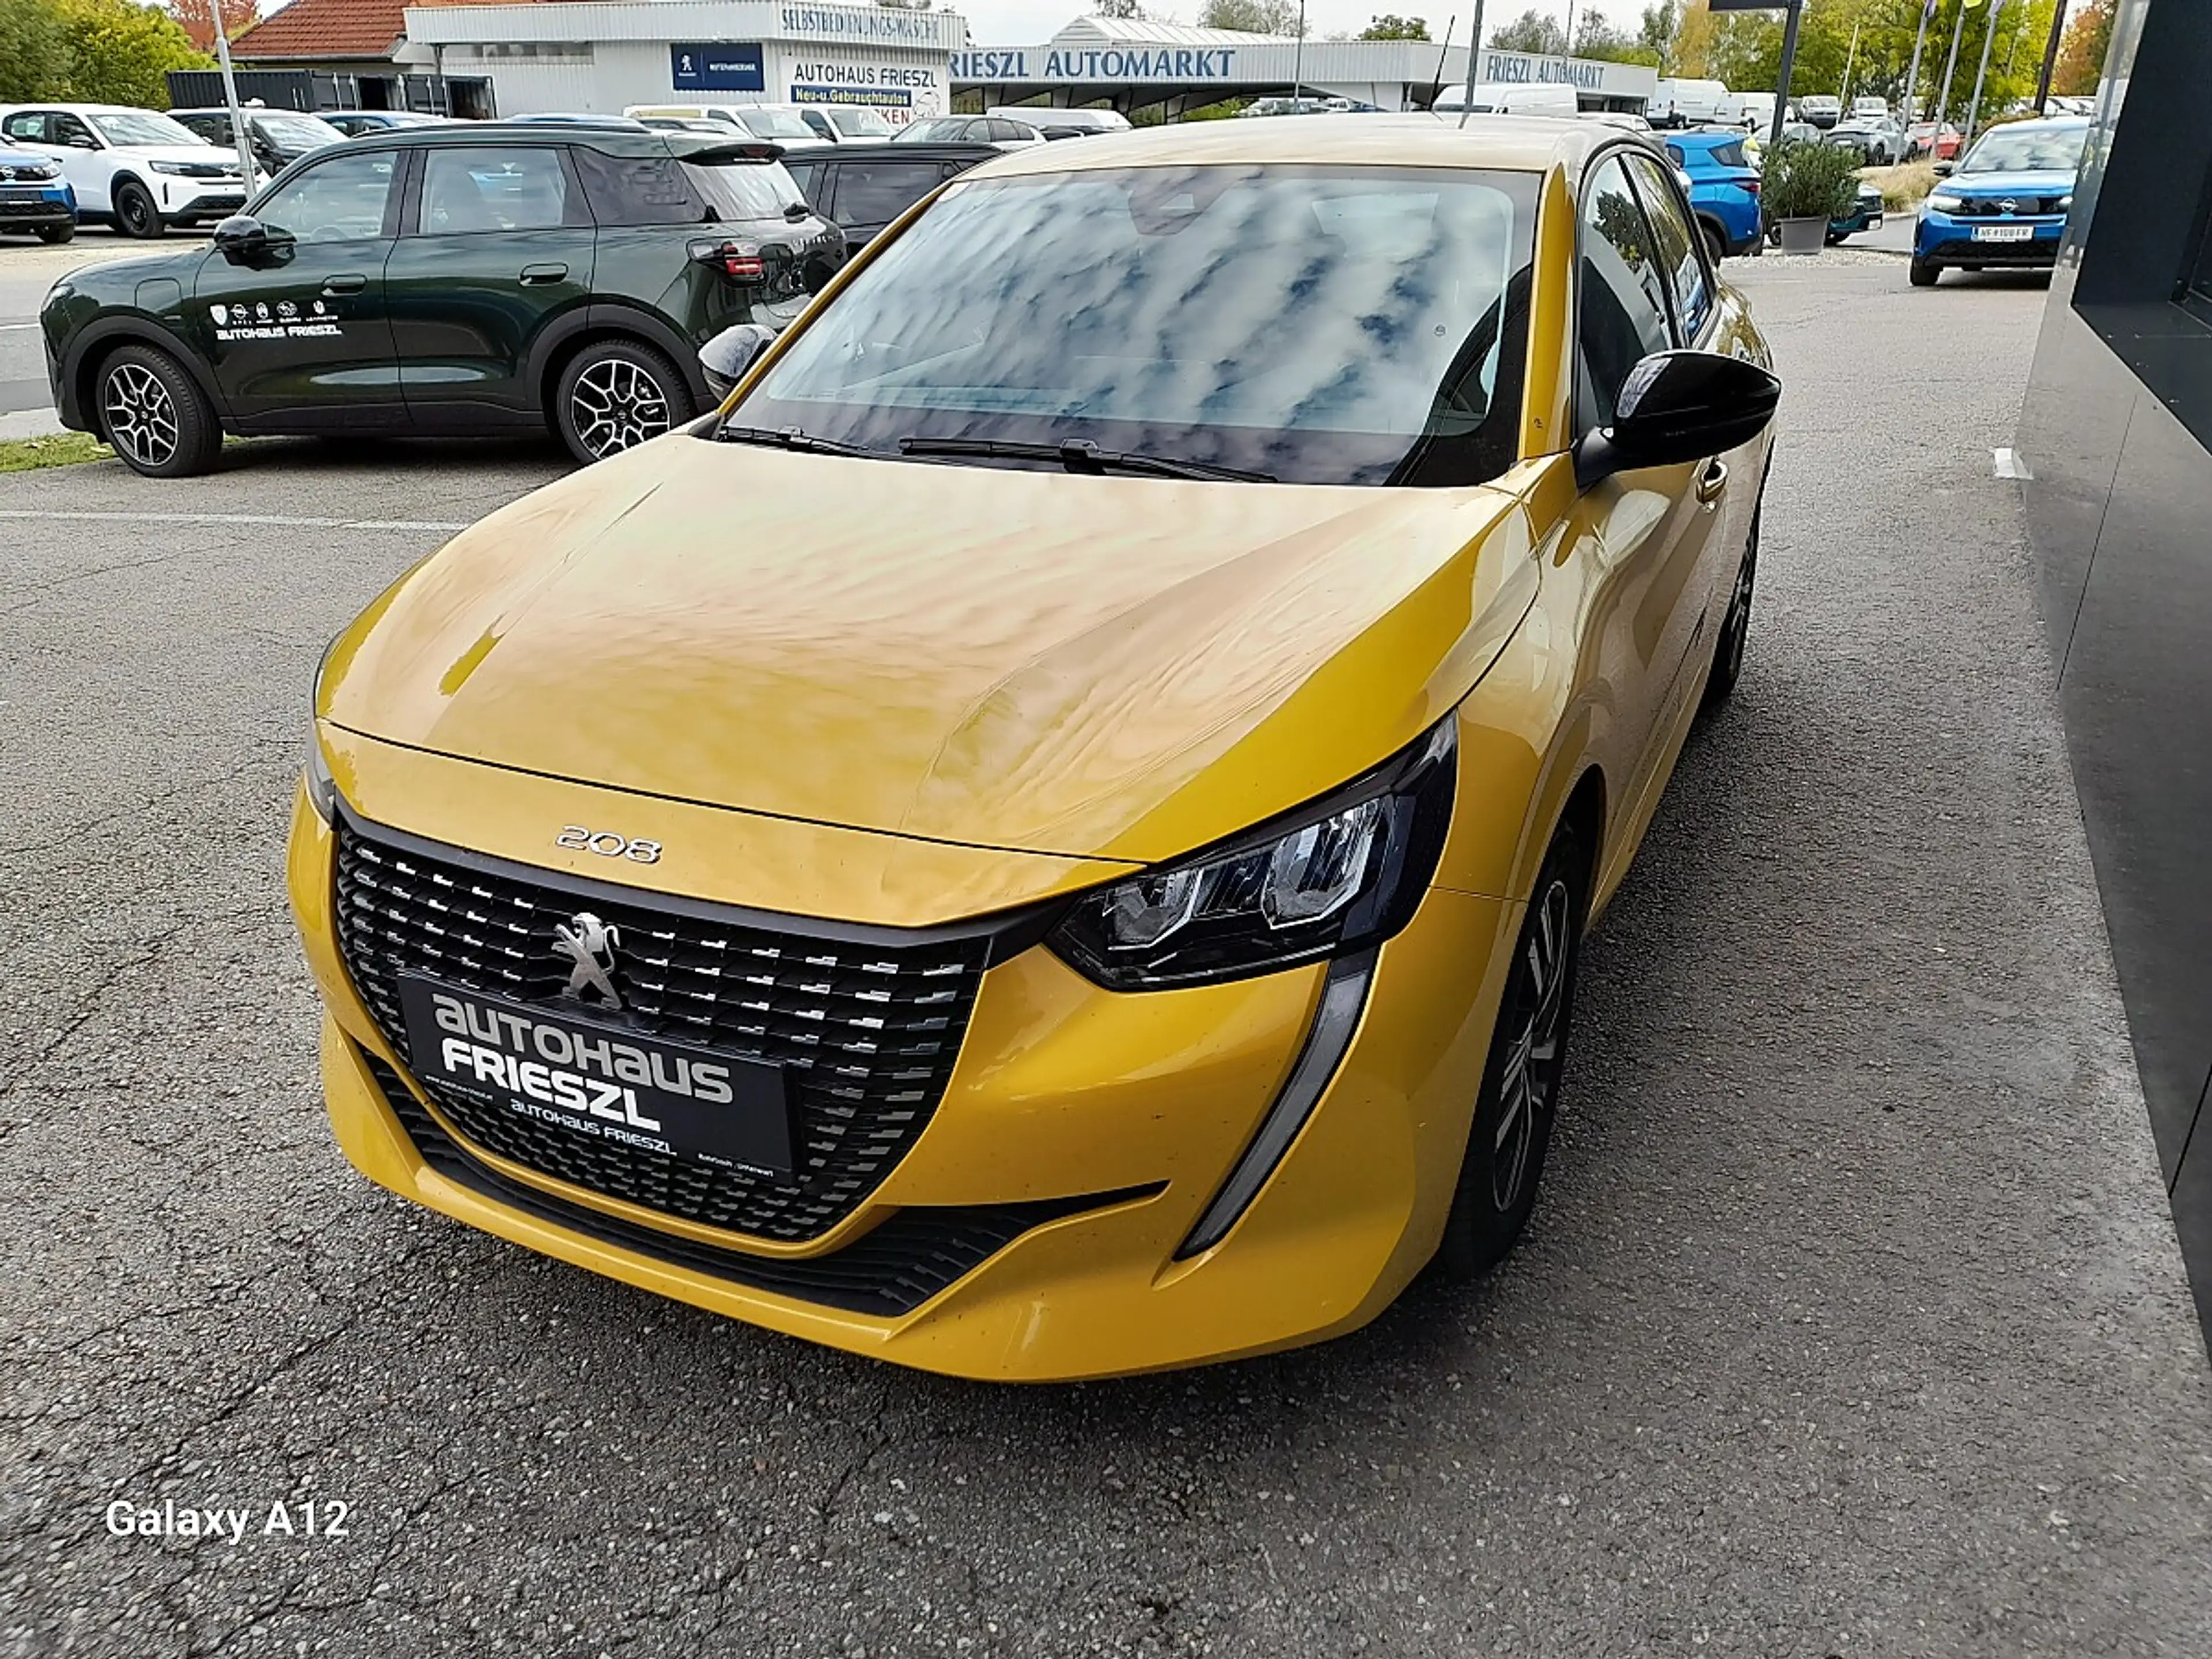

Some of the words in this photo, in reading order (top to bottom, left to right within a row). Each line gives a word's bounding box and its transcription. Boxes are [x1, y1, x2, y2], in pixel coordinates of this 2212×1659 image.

[794, 63, 874, 84] AUTOHAUS
[880, 67, 938, 88] FRIESZL
[1044, 50, 1236, 78] AUTOMARKT
[1486, 55, 1531, 83] FRIESZL
[1536, 59, 1604, 89] AUTOMARKT
[555, 824, 663, 864] 208
[441, 1037, 661, 1133] FRIESZL
[603, 1125, 678, 1157] FRIESZL
